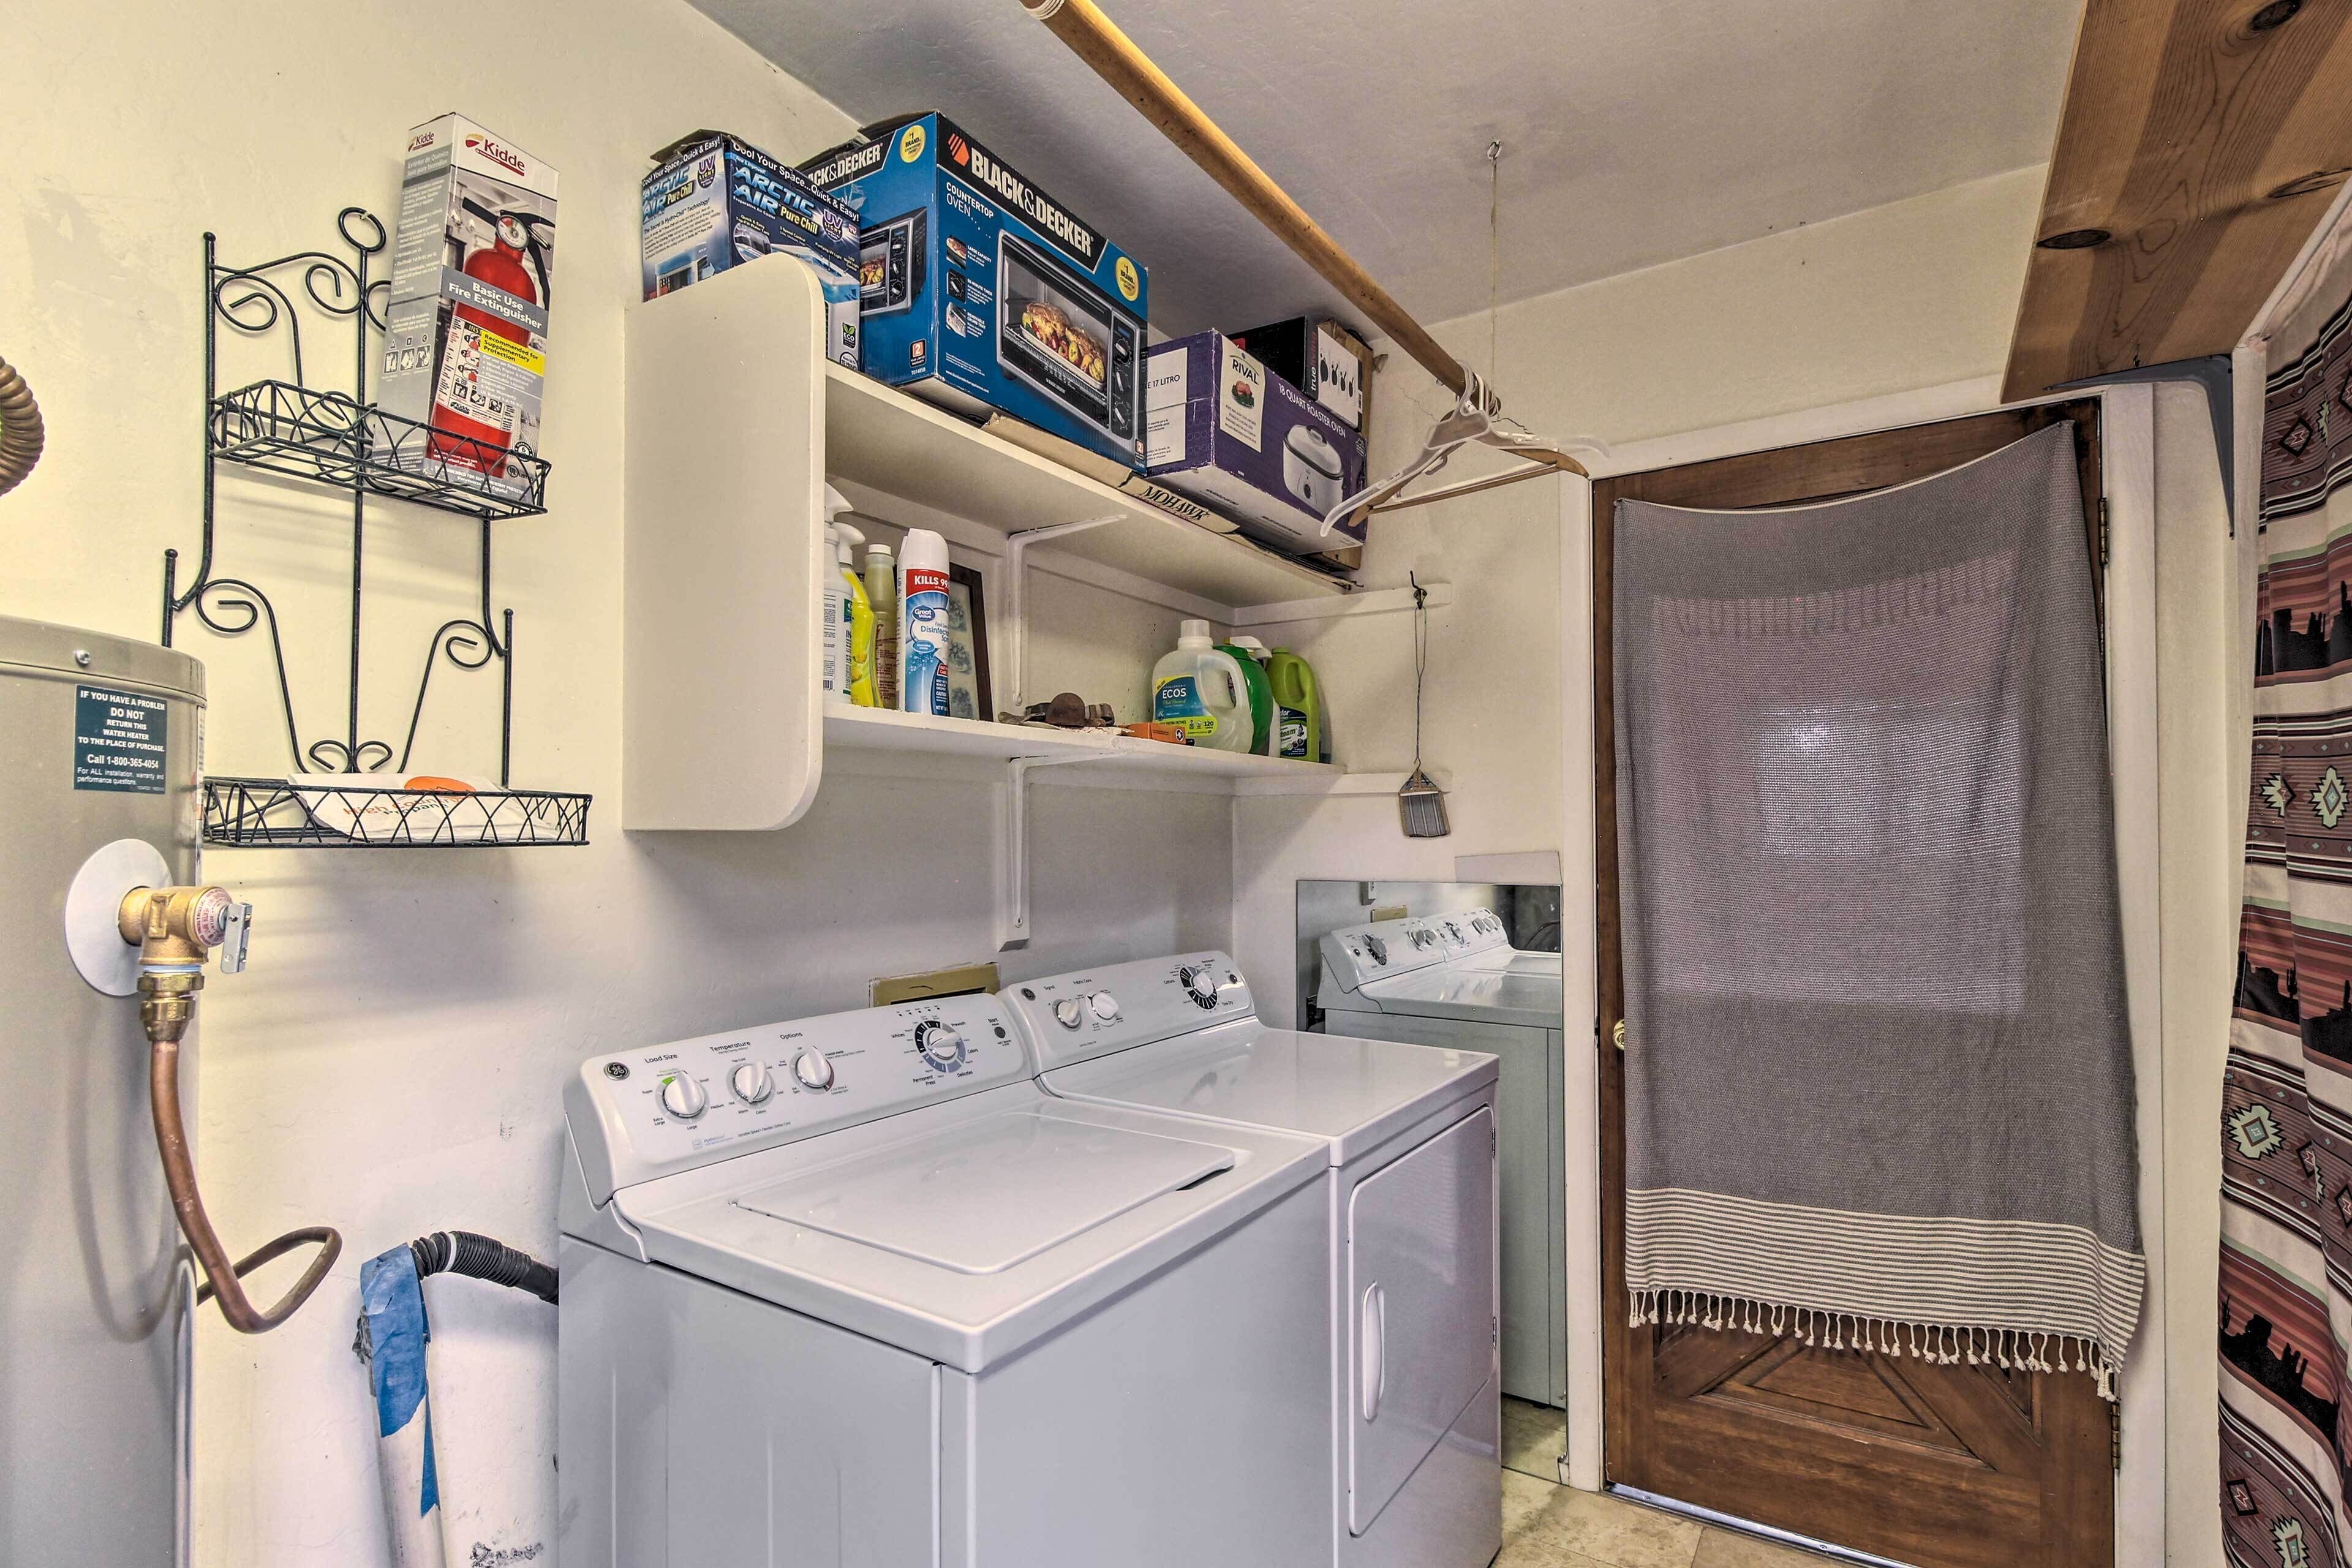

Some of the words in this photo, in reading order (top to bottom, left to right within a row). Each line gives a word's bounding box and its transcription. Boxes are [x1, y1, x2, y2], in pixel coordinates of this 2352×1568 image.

[415, 132, 434, 145] Kidde
[905, 137, 919, 148] BRAND
[484, 139, 525, 171] Kidde
[653, 170, 665, 180] Your
[699, 145, 704, 154] &
[704, 136, 720, 151] Easy!
[698, 154, 717, 174] UV
[699, 169, 715, 179] LIGHT
[808, 144, 881, 186] ACK&DECKER
[643, 165, 690, 200] ARCTIC
[733, 166, 815, 217] ARCTIC
[756, 153, 778, 173] Your
[832, 200, 839, 209] &
[839, 202, 860, 222] Easy!
[643, 194, 667, 222] AIR
[667, 189, 680, 205] Pure
[680, 181, 693, 198] Chill
[733, 184, 779, 216] AIR
[780, 205, 800, 225] Pure
[800, 216, 818, 235] Chill
[946, 182, 994, 219] COUNTERTOP
[946, 192, 971, 217] OVEN
[971, 147, 1091, 257] BLACK&DECKER
[824, 208, 843, 229] UV
[824, 222, 842, 235] LIGHT
[448, 282, 472, 299] Fire
[473, 293, 542, 330] Extinguisher
[472, 282, 502, 302] Basic
[503, 296, 524, 311] Use
[484, 334, 529, 356] Recommended
[843, 332, 854, 341] ECO
[483, 346, 516, 362] Protection
[484, 340, 530, 363] Supplementary
[914, 343, 922, 357] 2
[1153, 379, 1159, 388] 17
[1160, 374, 1180, 386] LITRO
[1232, 358, 1259, 385] RIVAL
[1278, 383, 1286, 396] 18
[1286, 388, 1306, 410] QUART
[1306, 403, 1331, 428] ROASTER
[1330, 421, 1346, 439] OVEN
[1137, 442, 1143, 453] 2
[518, 473, 534, 482] LISTD
[1139, 486, 1207, 521] MOHAWK
[914, 576, 939, 585] KILLS
[91, 692, 108, 701] YOU
[110, 695, 130, 705] HAVE
[137, 700, 165, 710] PROBLEM
[1163, 688, 1186, 699] ECOS
[110, 707, 124, 717] DO
[126, 709, 145, 720] NOT
[107, 719, 133, 728] RETURN
[103, 729, 126, 737] WATER
[126, 732, 149, 741] HEATER
[137, 743, 165, 752] PURCHASE.
[87, 754, 105, 764] Call
[107, 756, 159, 769] 1-800-365-4054
[709, 1041, 751, 1052] Temperature
[913, 1074, 933, 1083] Permanent
